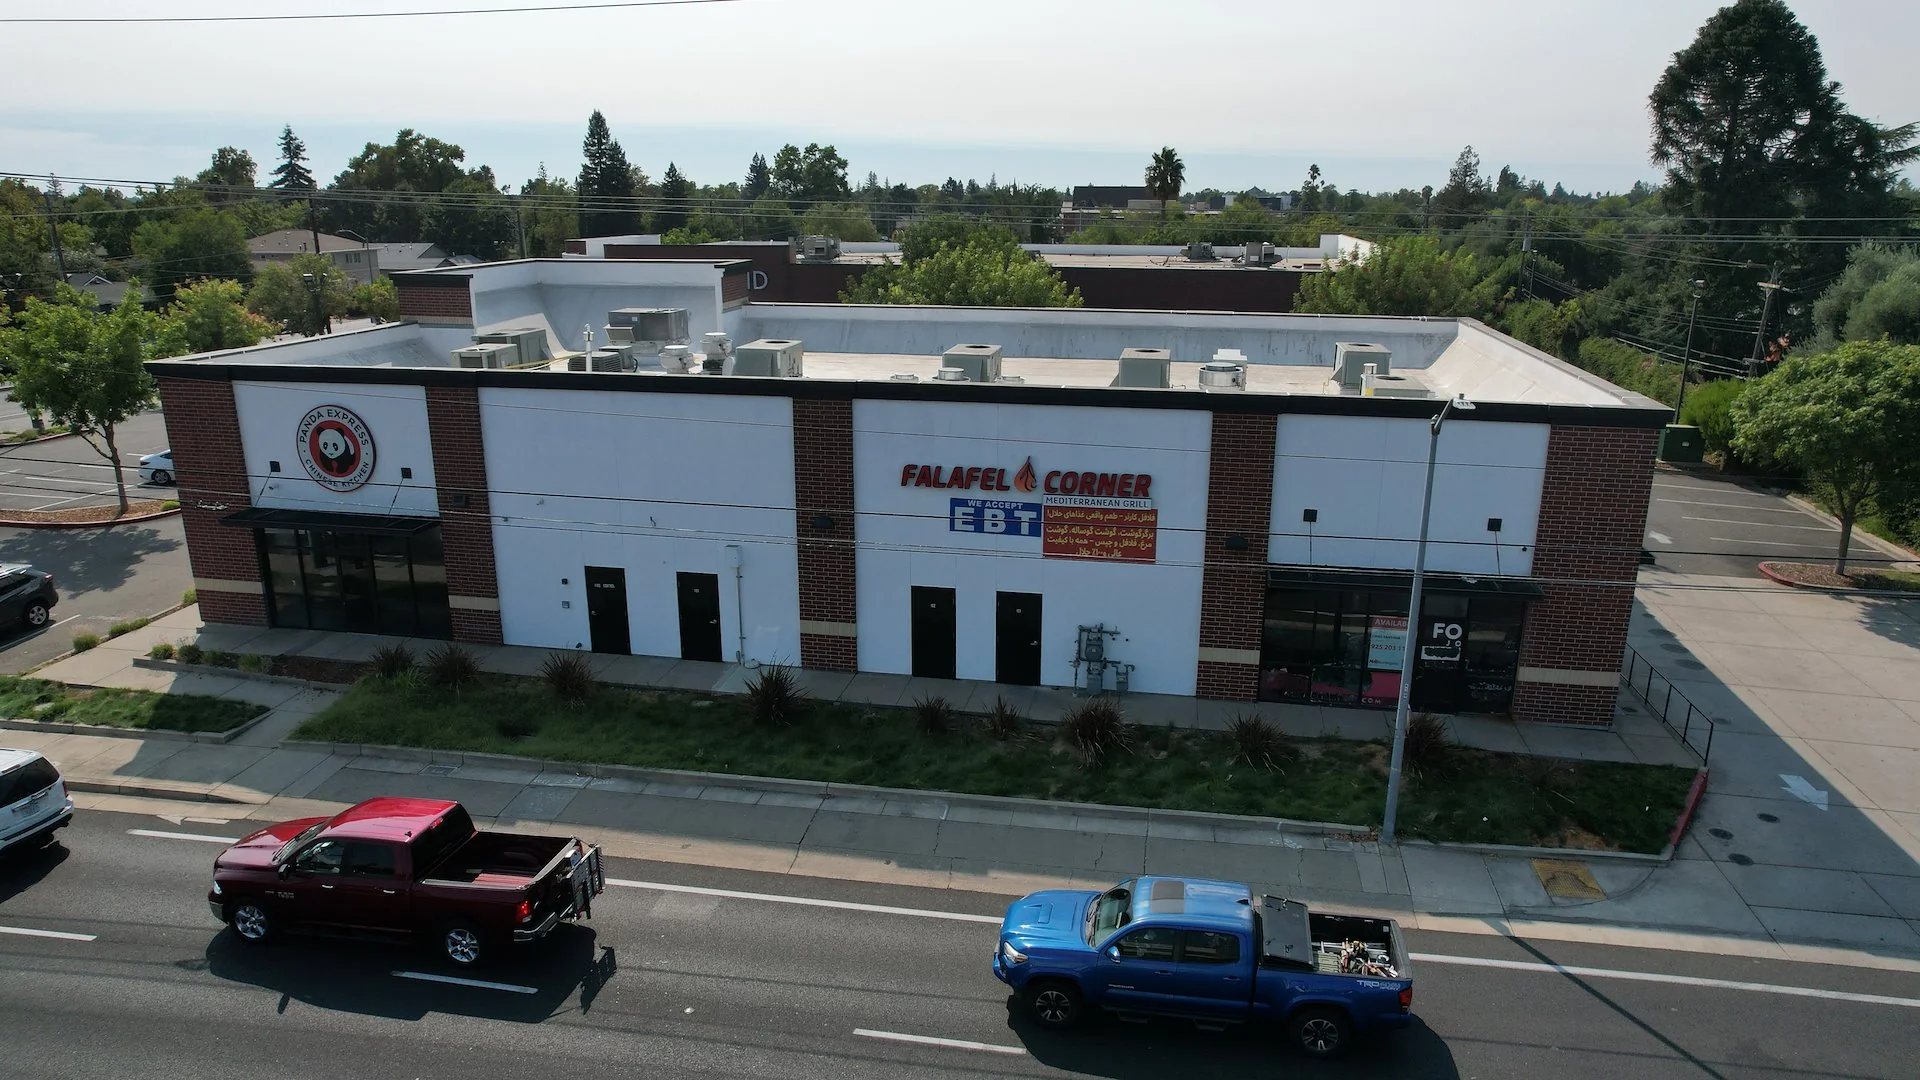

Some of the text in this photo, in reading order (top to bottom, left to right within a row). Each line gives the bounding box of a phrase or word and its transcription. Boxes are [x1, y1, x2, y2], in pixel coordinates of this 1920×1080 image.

[300, 409, 368, 446] PANDA EXPRESS
[901, 464, 1152, 496] FALAFEL CORNER
[985, 501, 1023, 510] ACCEPT
[1045, 497, 1148, 508] MEDITERRANEAN GRILL
[954, 506, 1037, 535] EBT
[1374, 618, 1407, 626] AVAILAB
[1433, 623, 1462, 640] FO
